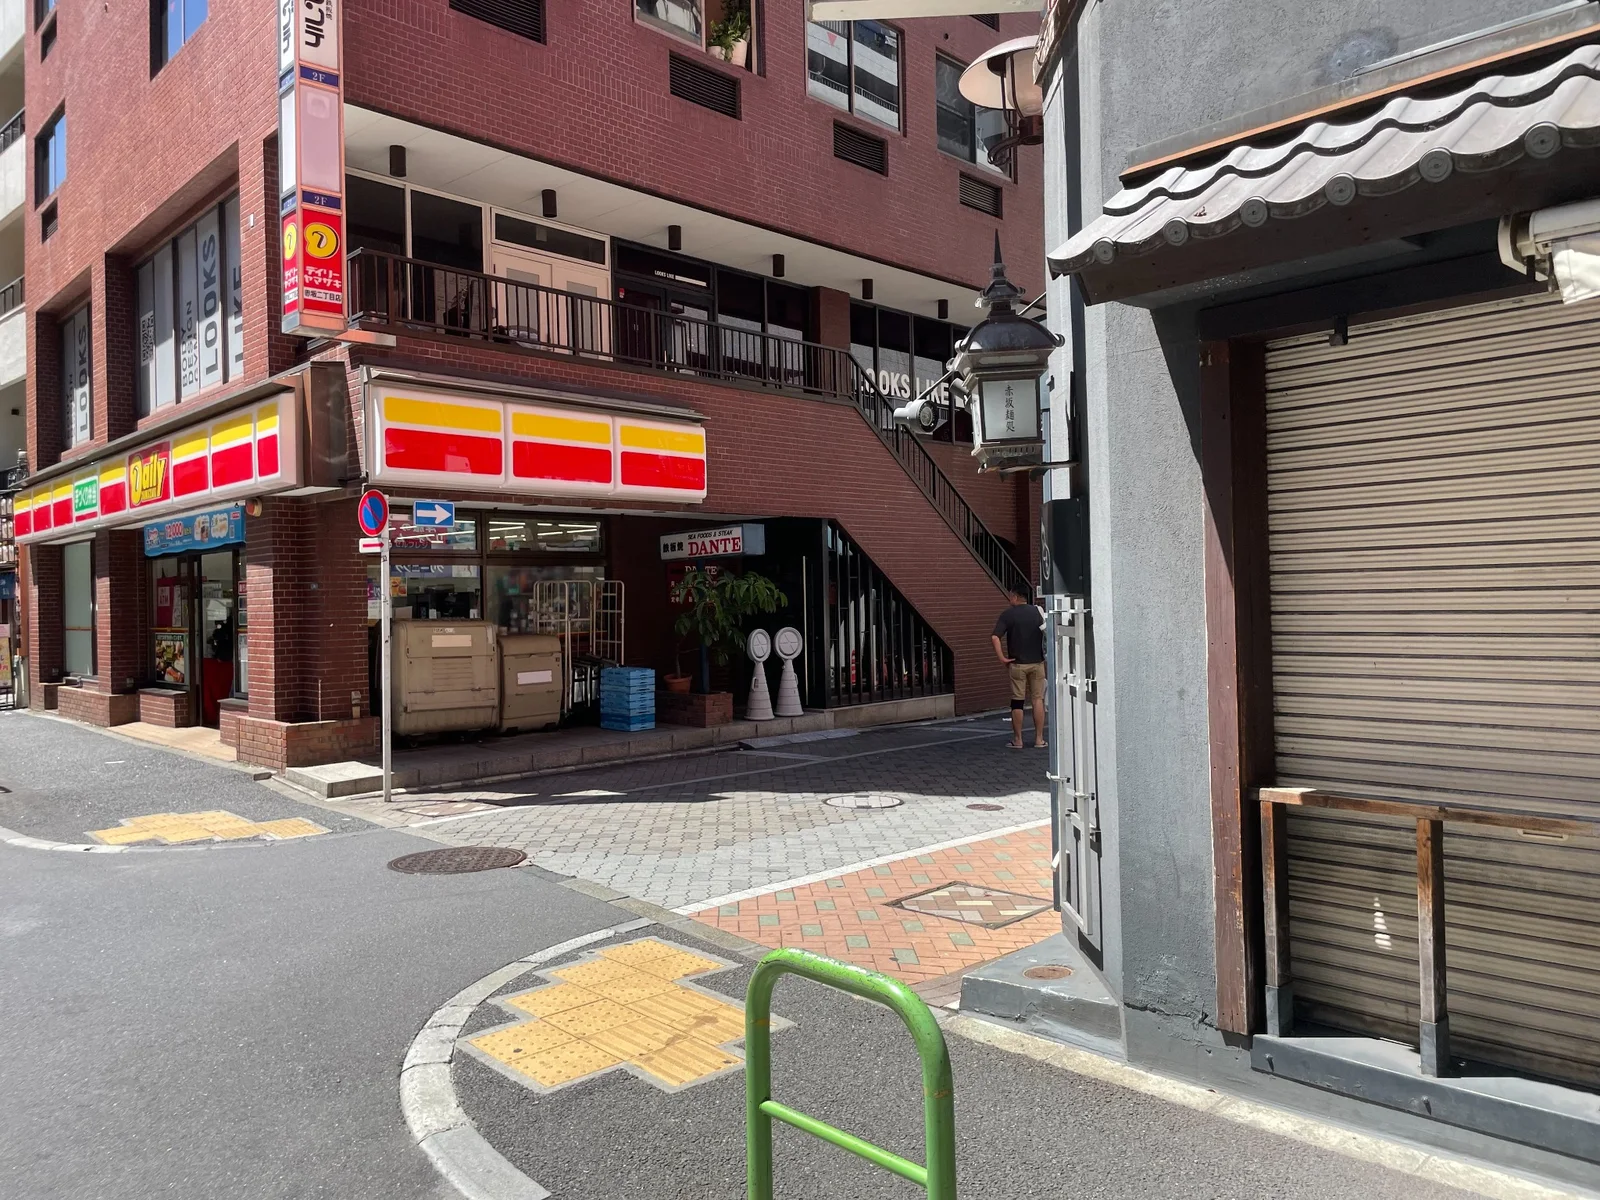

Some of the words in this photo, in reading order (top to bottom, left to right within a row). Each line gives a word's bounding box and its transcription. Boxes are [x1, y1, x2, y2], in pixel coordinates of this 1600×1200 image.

[312, 71, 326, 82] 2F
[314, 195, 328, 206] 2F
[305, 265, 340, 279] デイリー
[654, 270, 667, 278] LOOKS
[303, 274, 342, 289] ヤマザキ
[203, 234, 219, 376] LOOKS
[186, 301, 194, 385] DESIGN
[78, 324, 88, 432] LOOKS
[1004, 384, 1016, 432] 赤坂麺処
[129, 451, 167, 506] Daily
[662, 541, 684, 553] 鉄板焼
[688, 537, 741, 556] DANTE
